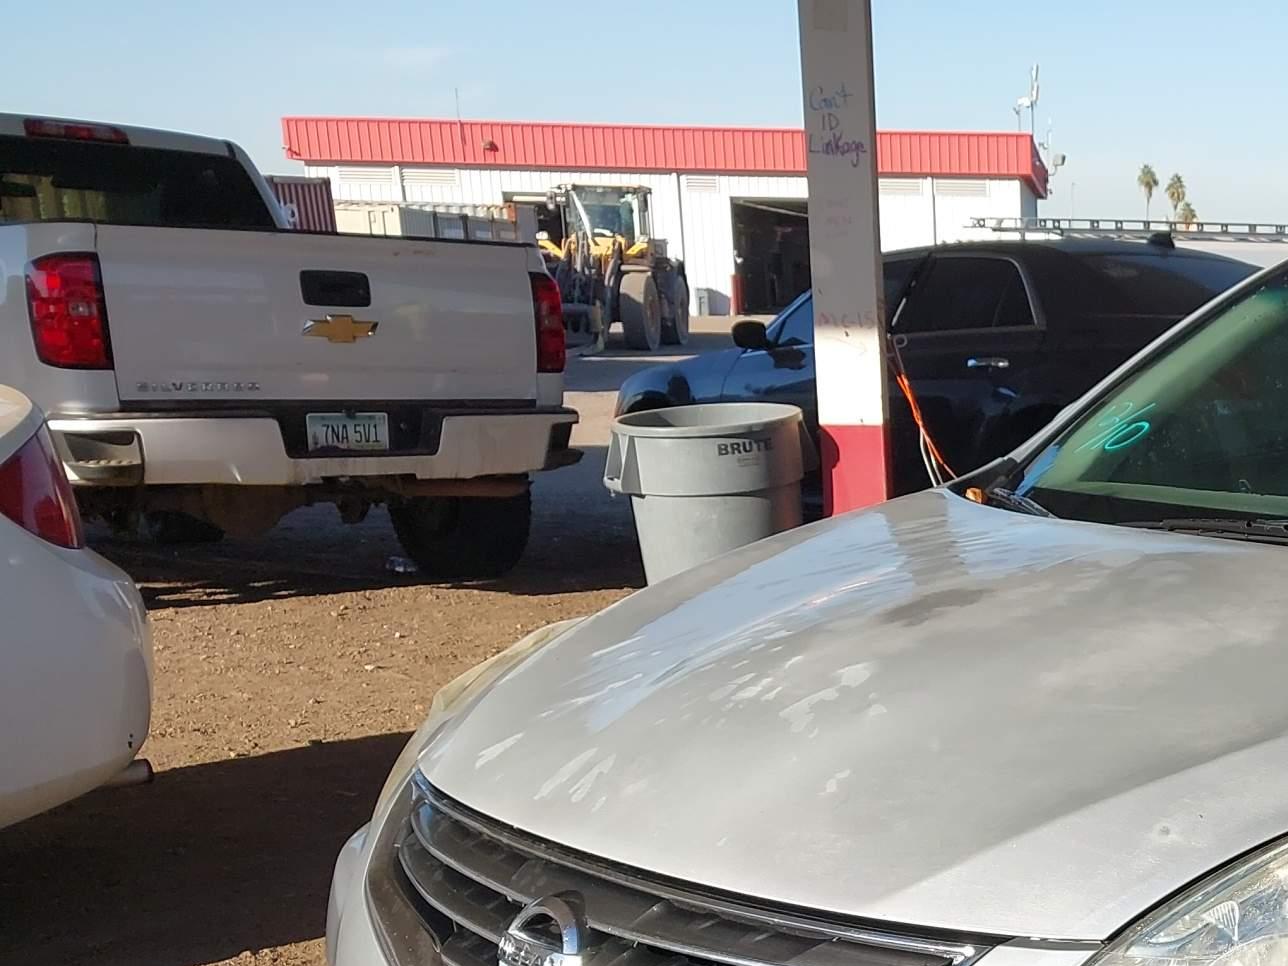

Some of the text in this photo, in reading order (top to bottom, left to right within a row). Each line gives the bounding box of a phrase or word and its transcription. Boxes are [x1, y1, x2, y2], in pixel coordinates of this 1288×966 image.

[821, 113, 840, 131] ID
[808, 131, 868, 168] Linkage
[321, 423, 381, 444] 7NA 5V1
[716, 438, 774, 457] BRUTE
